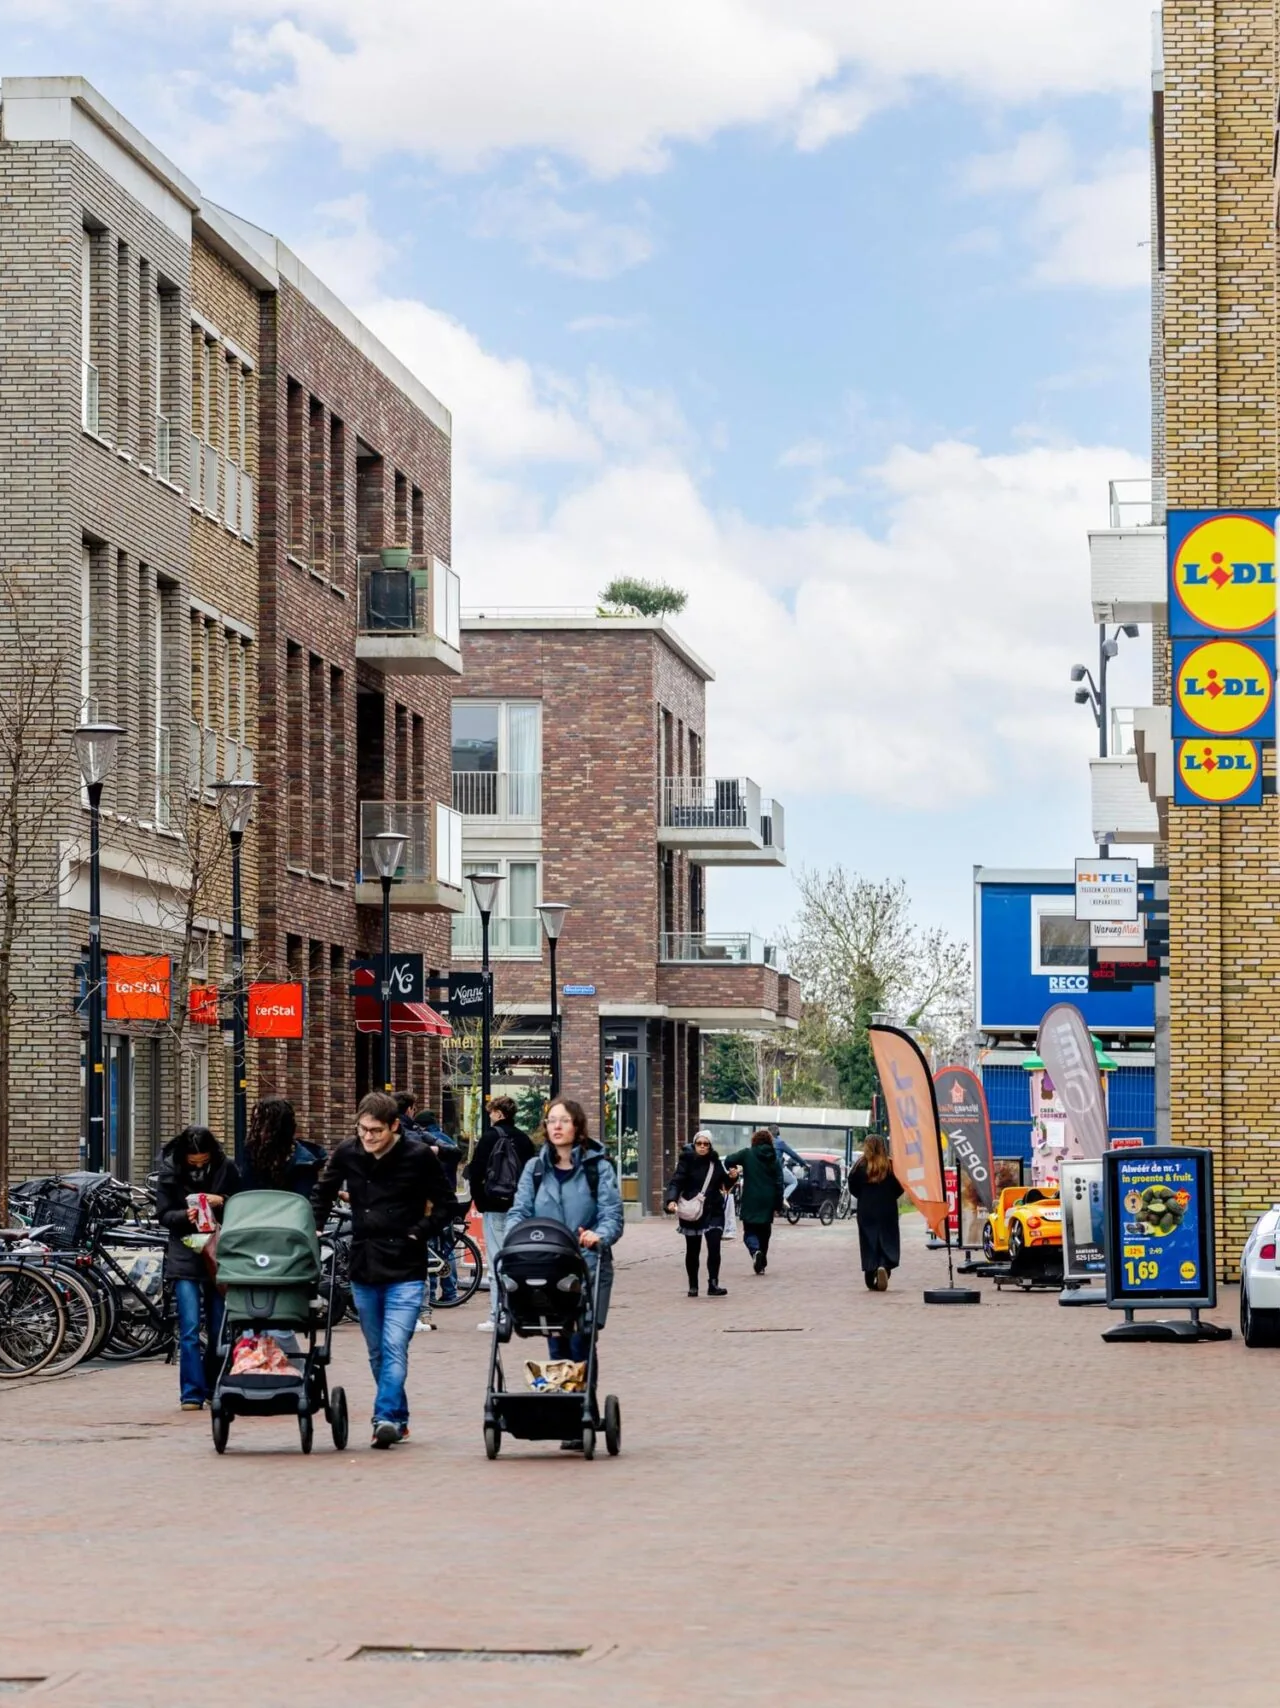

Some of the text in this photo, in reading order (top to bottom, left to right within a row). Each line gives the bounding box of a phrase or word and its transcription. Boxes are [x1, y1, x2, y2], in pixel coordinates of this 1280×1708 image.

[1078, 874, 1134, 882] RITEL
[116, 981, 160, 994] terStal
[1049, 976, 1088, 989] RECO
[255, 1004, 295, 1016] terStal
[1151, 1163, 1161, 1172] de
[1122, 1174, 1130, 1183] in
[1131, 1175, 1163, 1184] groente
[1165, 1174, 1171, 1182] &
[1124, 1261, 1158, 1285] 1.69
